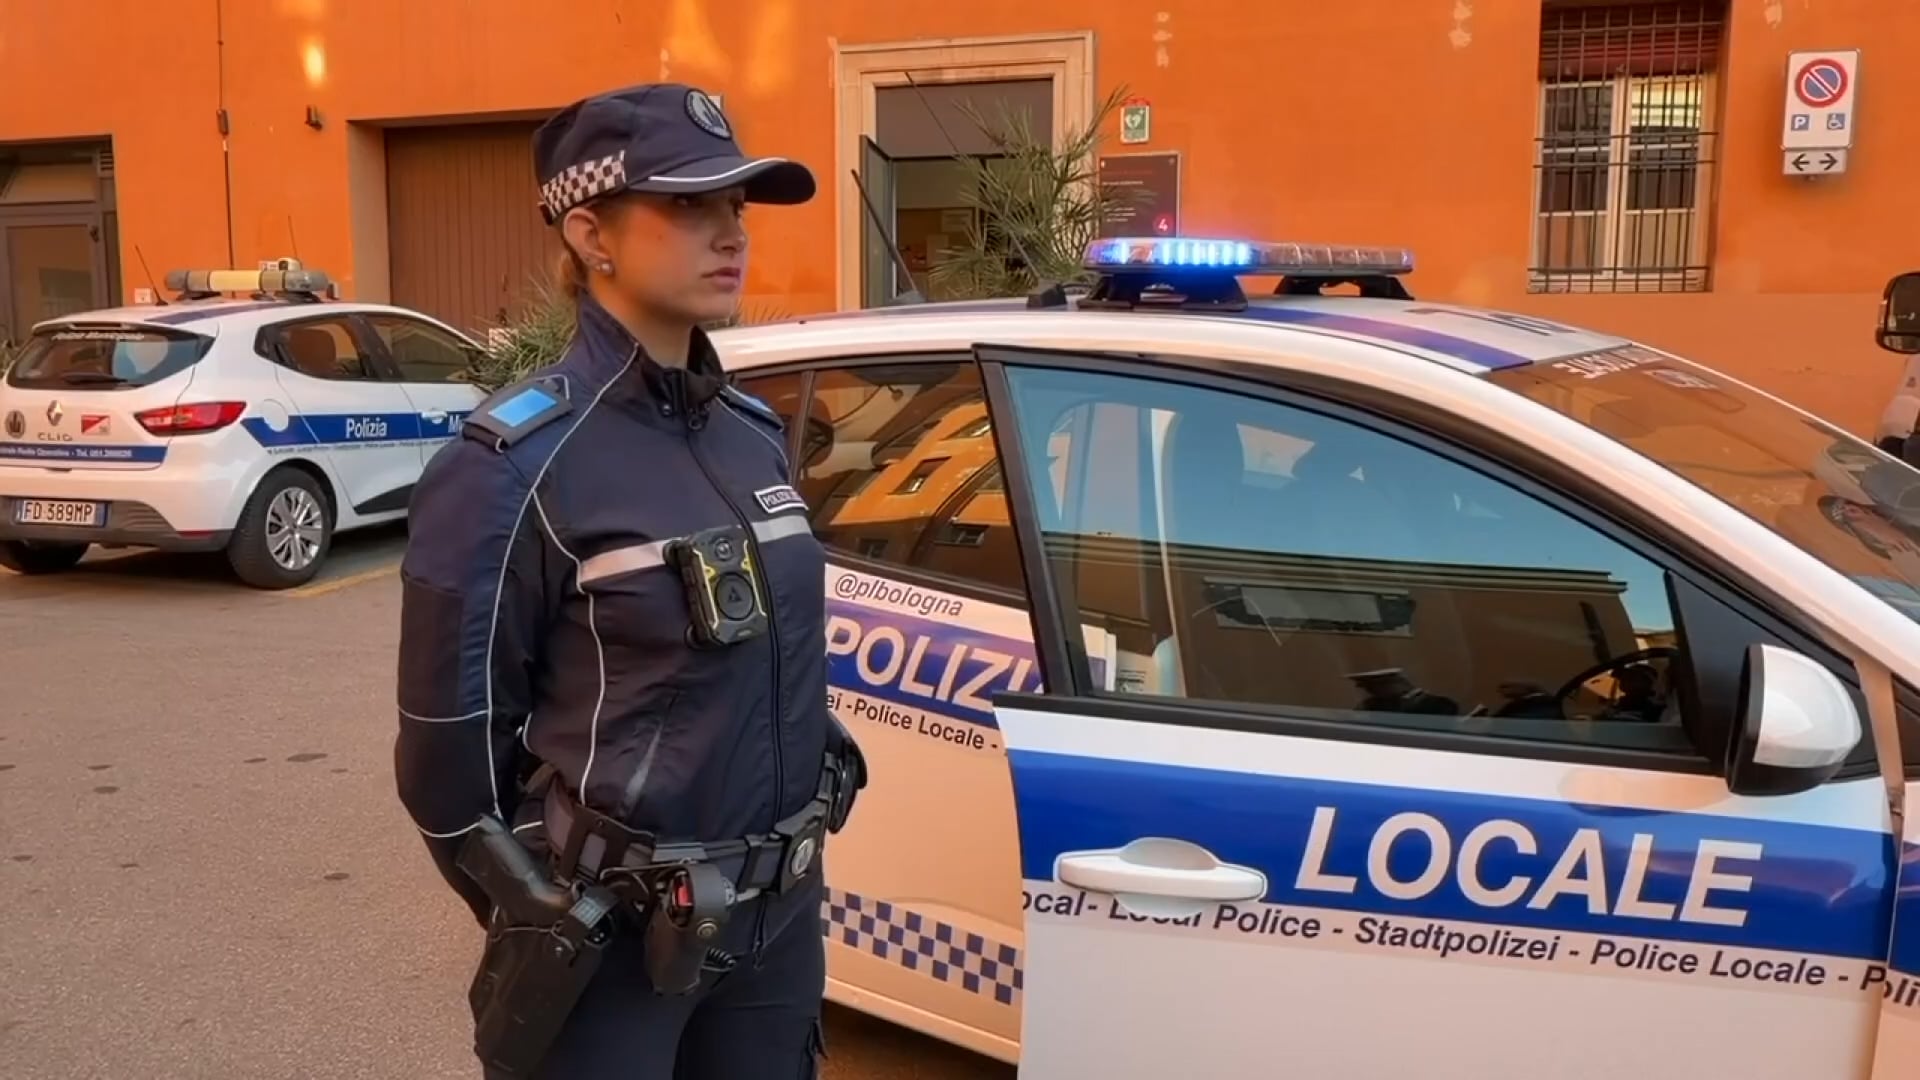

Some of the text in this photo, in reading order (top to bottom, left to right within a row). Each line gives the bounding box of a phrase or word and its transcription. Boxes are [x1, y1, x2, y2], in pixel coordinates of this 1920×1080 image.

[1158, 218, 1168, 232] 4
[345, 416, 387, 439] Polizia
[24, 502, 93, 523] FD 389MP
[834, 573, 964, 617] @plbologna
[825, 615, 1044, 714] POLIZI
[918, 714, 985, 750] Locale
[1294, 805, 1763, 927] LOCALE
[1212, 904, 1321, 938] Police
[1354, 916, 1561, 959] Stadtpolizei
[1590, 938, 1699, 975] Police
[1709, 950, 1826, 986] Locale
